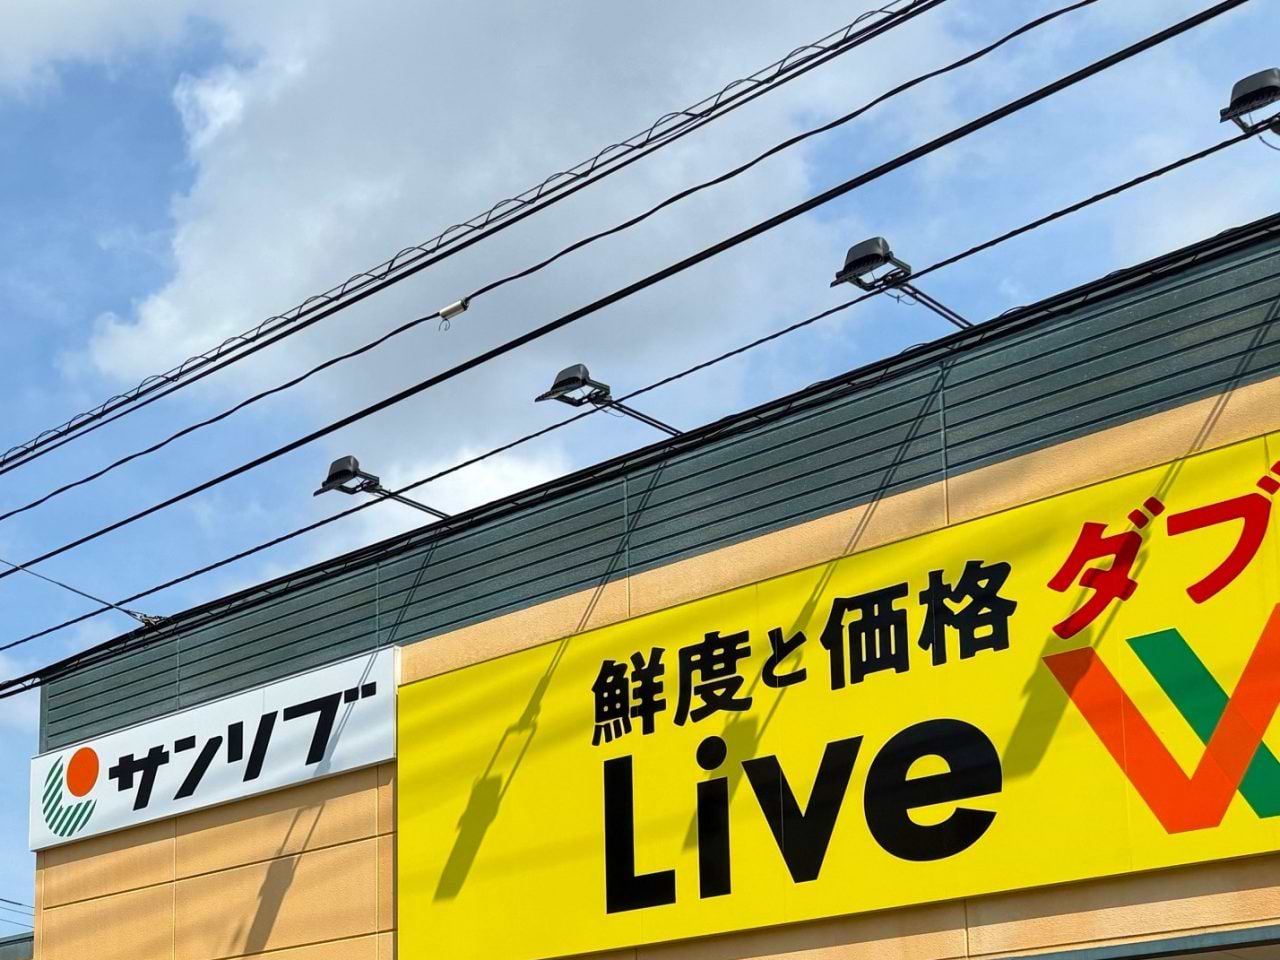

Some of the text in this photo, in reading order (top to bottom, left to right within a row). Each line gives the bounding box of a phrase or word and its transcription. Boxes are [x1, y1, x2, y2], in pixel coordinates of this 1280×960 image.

[109, 681, 377, 811] サンリブ
[591, 559, 1018, 747] 鮮度と価格
[603, 717, 1003, 914] Live
